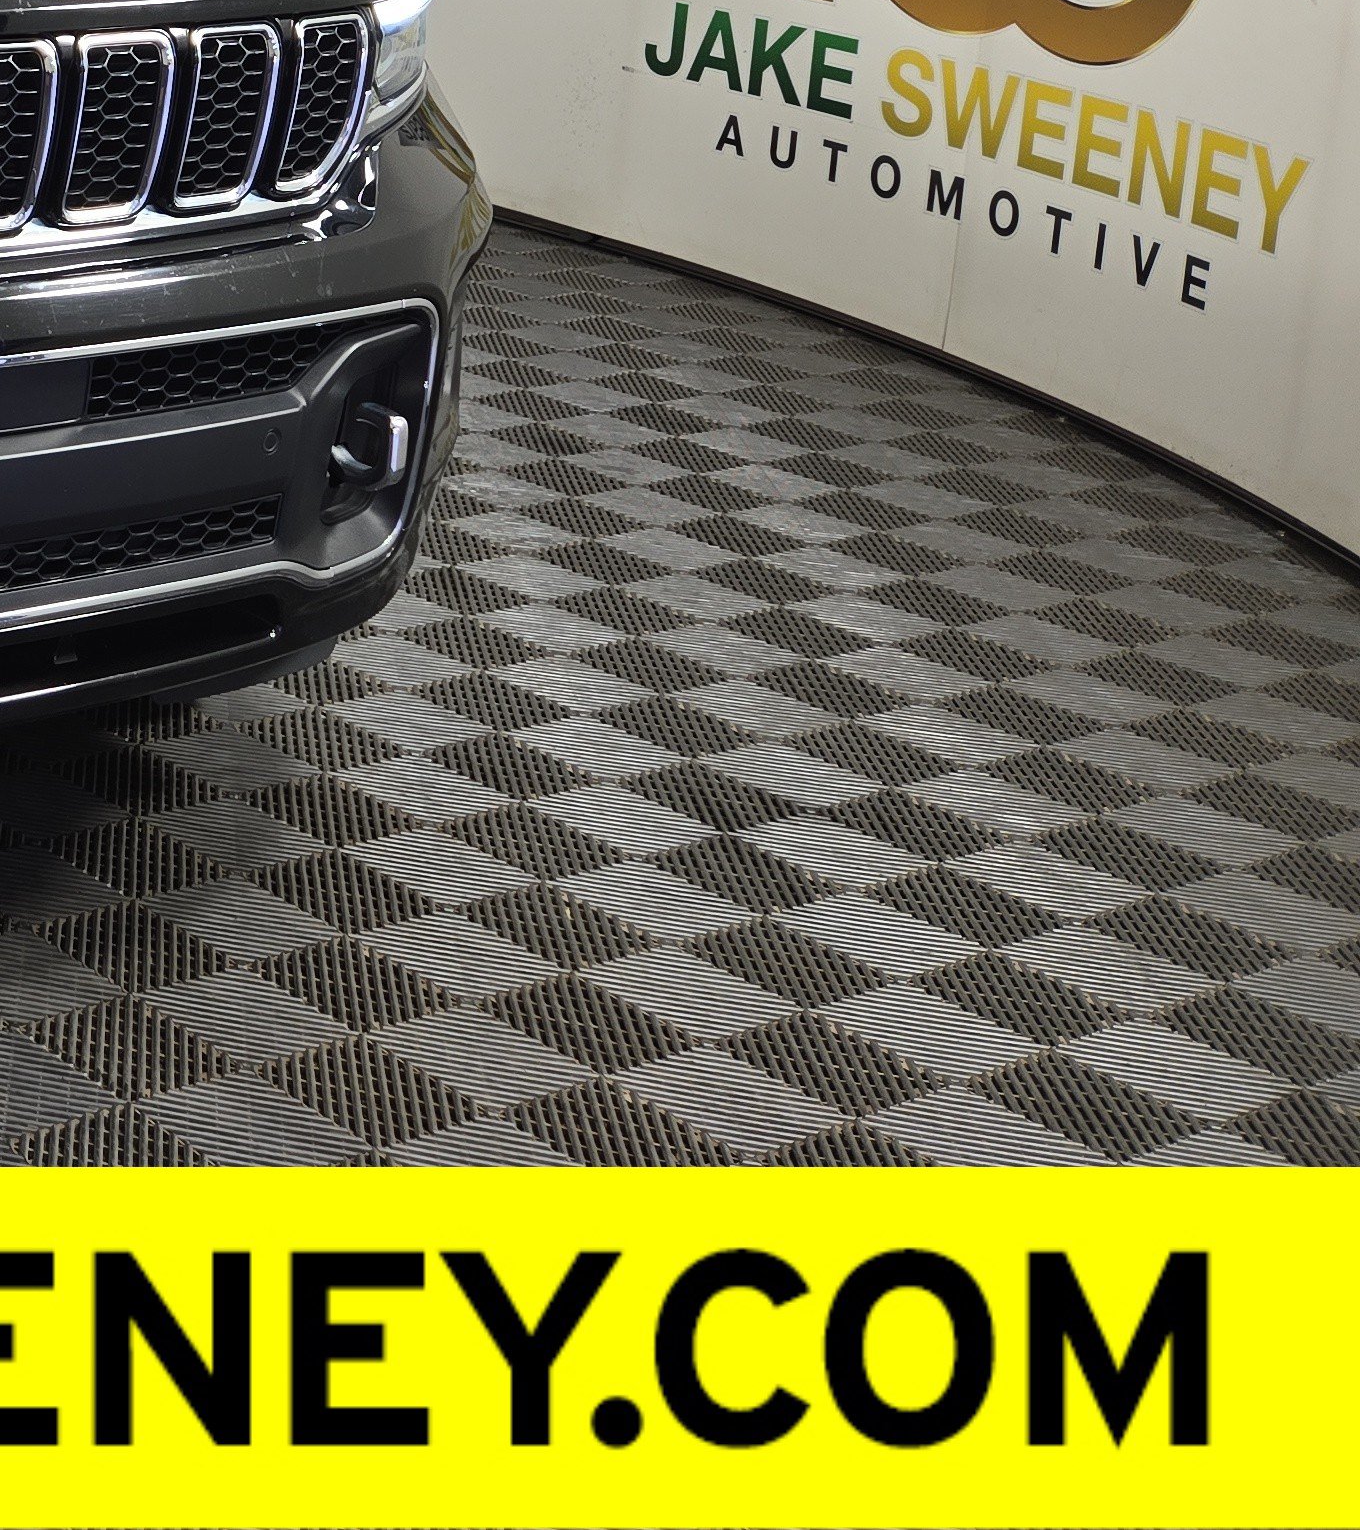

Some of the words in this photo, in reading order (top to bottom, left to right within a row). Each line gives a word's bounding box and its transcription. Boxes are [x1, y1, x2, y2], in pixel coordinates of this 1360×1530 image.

[644, 1, 860, 121] JAKE
[880, 47, 1311, 255] SWEENEY
[714, 114, 1212, 311] AUTOMOTIVE
